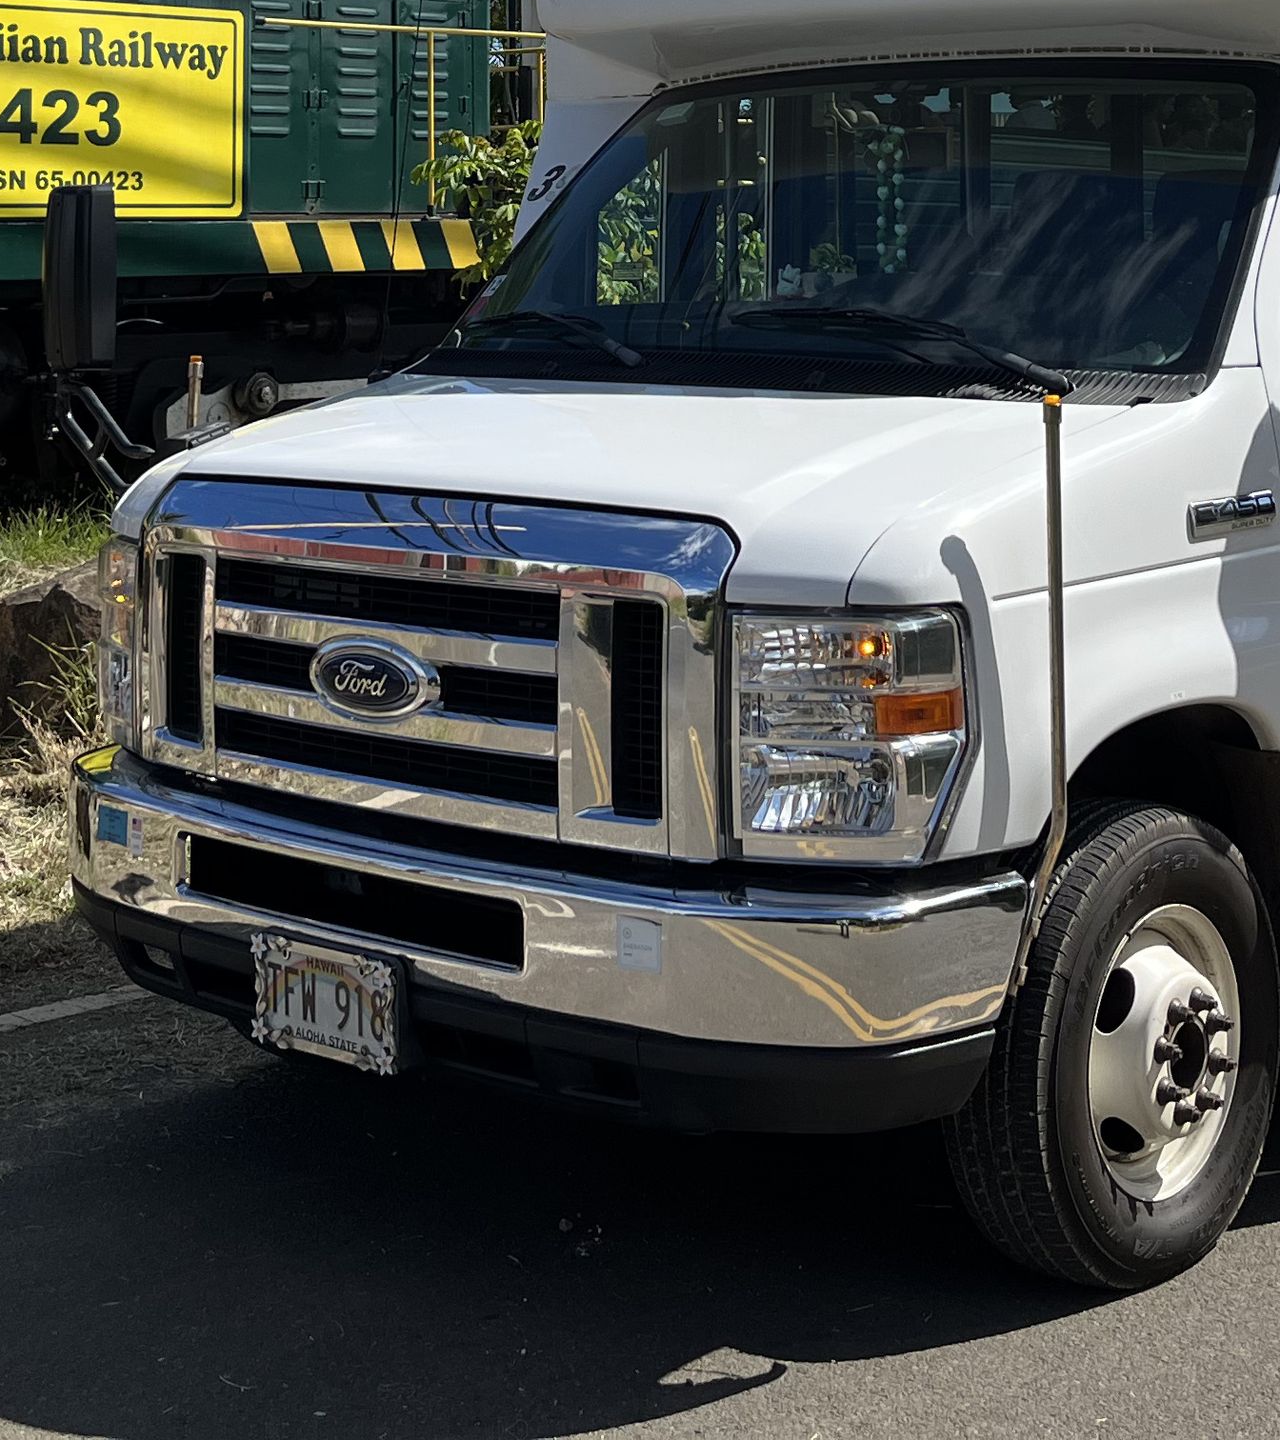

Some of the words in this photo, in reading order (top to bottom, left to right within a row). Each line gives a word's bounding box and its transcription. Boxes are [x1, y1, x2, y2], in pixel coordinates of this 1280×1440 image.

[78, 26, 229, 80] Railway
[35, 169, 144, 192] 65-00423
[334, 659, 388, 698] Ford
[306, 955, 344, 978] HAWAII
[268, 961, 316, 1024] TFW
[335, 980, 384, 1042] 918
[295, 1026, 326, 1046] ALOHA
[329, 1035, 358, 1055] STATE
